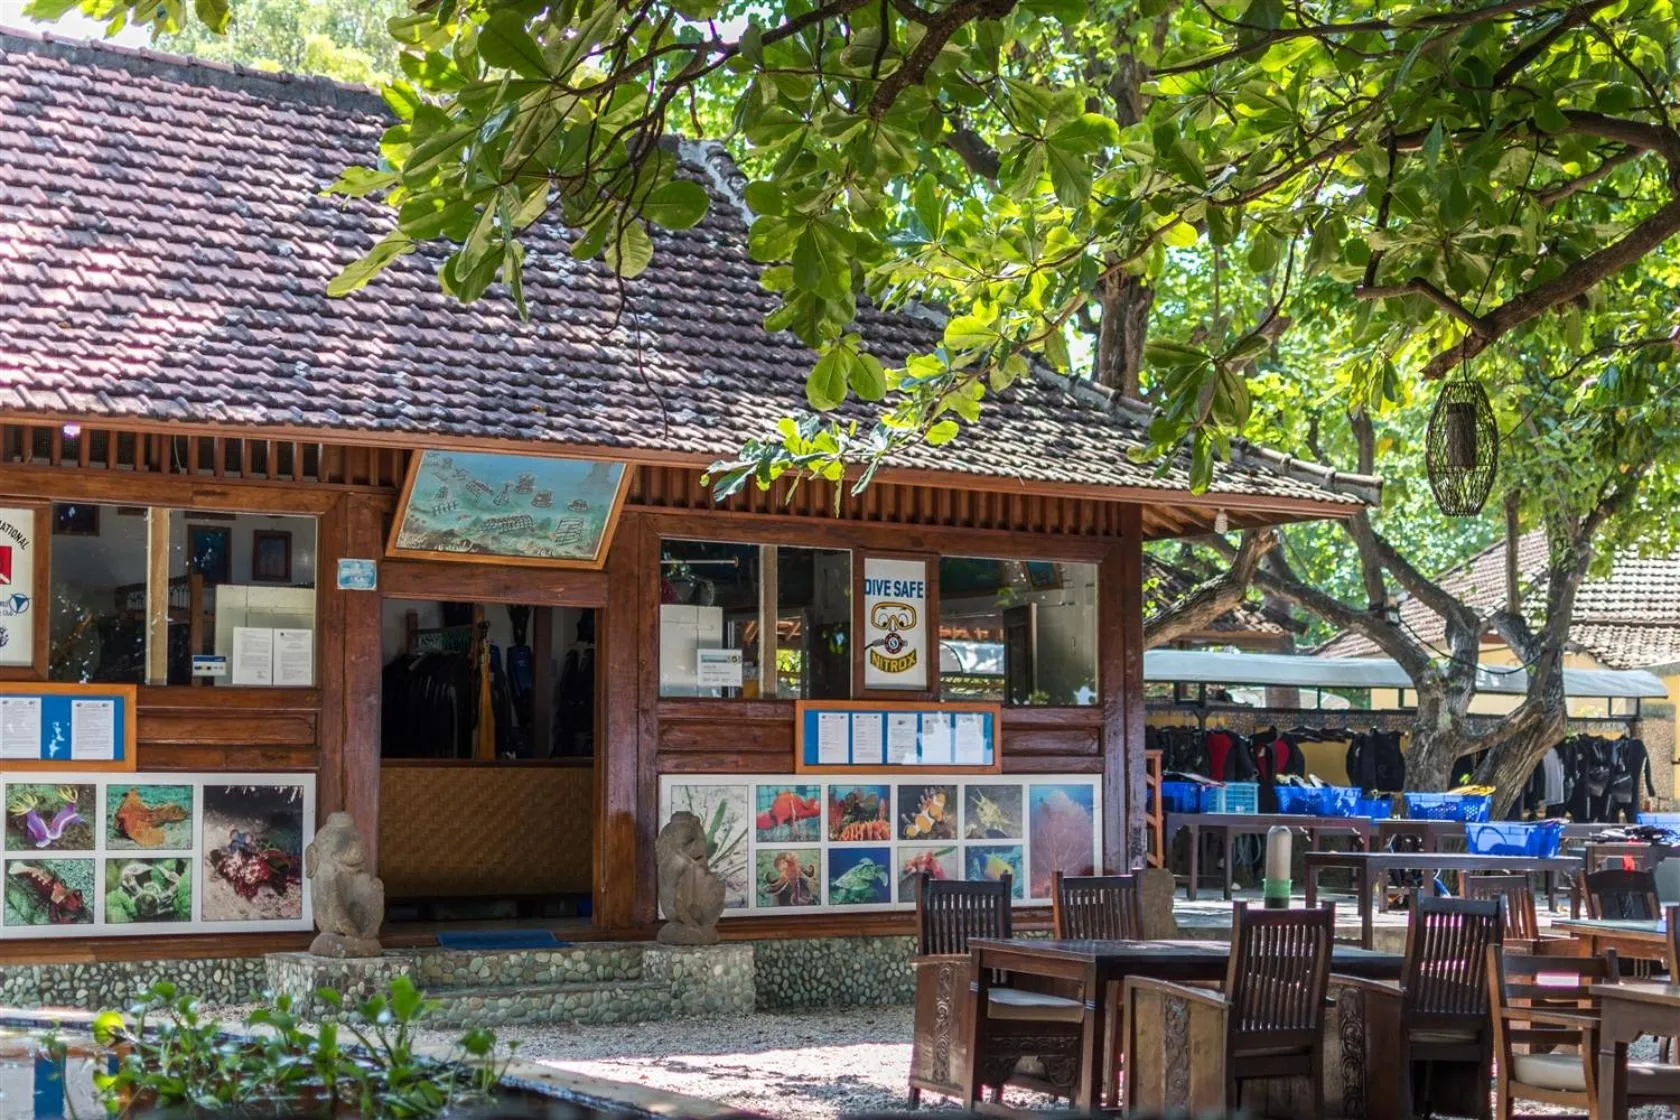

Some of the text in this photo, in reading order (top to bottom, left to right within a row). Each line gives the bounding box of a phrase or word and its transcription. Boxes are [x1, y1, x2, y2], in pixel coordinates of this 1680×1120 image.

[0, 519, 30, 551] ATIONAL
[864, 579, 924, 599] DIVE SAFE
[872, 651, 916, 672] NITROX
